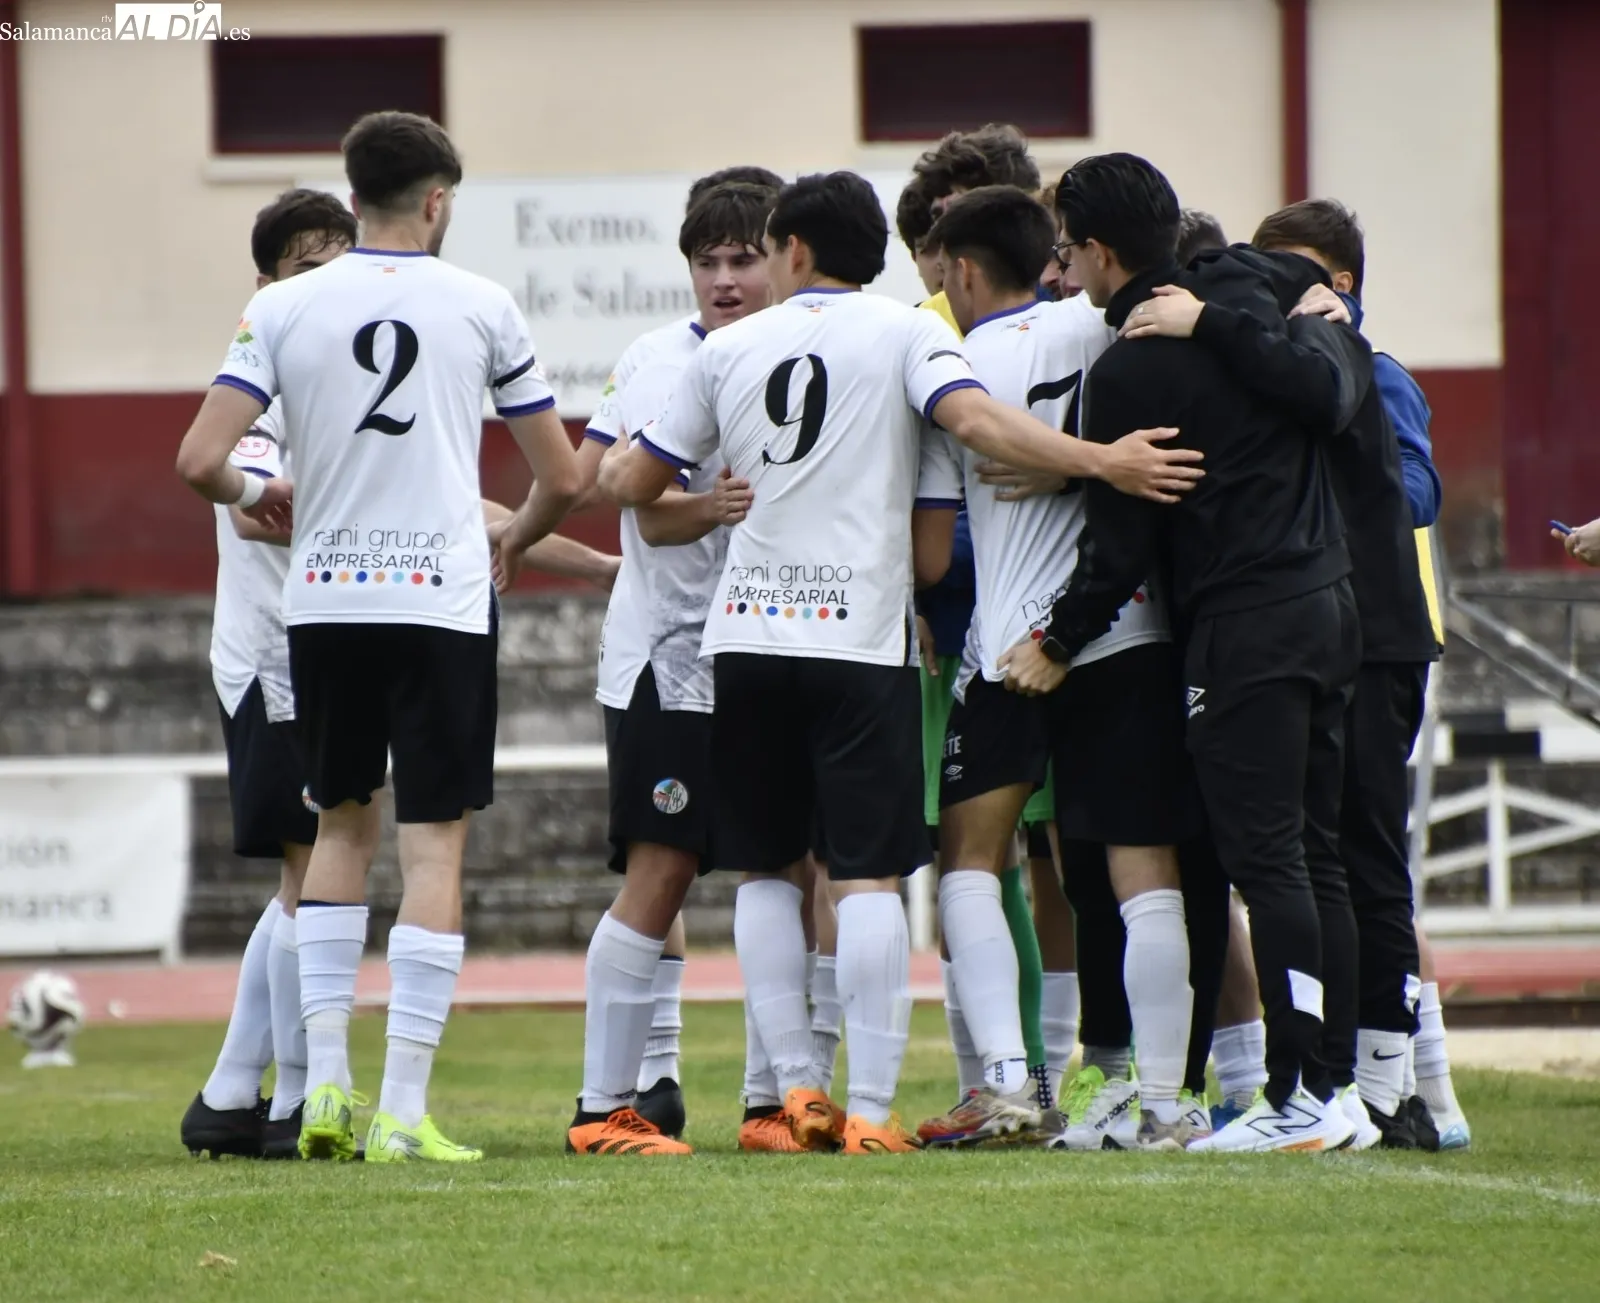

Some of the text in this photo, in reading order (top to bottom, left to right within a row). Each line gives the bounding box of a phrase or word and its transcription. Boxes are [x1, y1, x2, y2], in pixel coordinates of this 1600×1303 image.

[352, 319, 419, 436] 2
[762, 353, 828, 466] 9
[1027, 368, 1084, 494] 7
[368, 529, 446, 553] grupo
[306, 552, 444, 573] EMPRESARIAL
[778, 564, 853, 589] grupo
[727, 584, 850, 606] EMPRESARIAL
